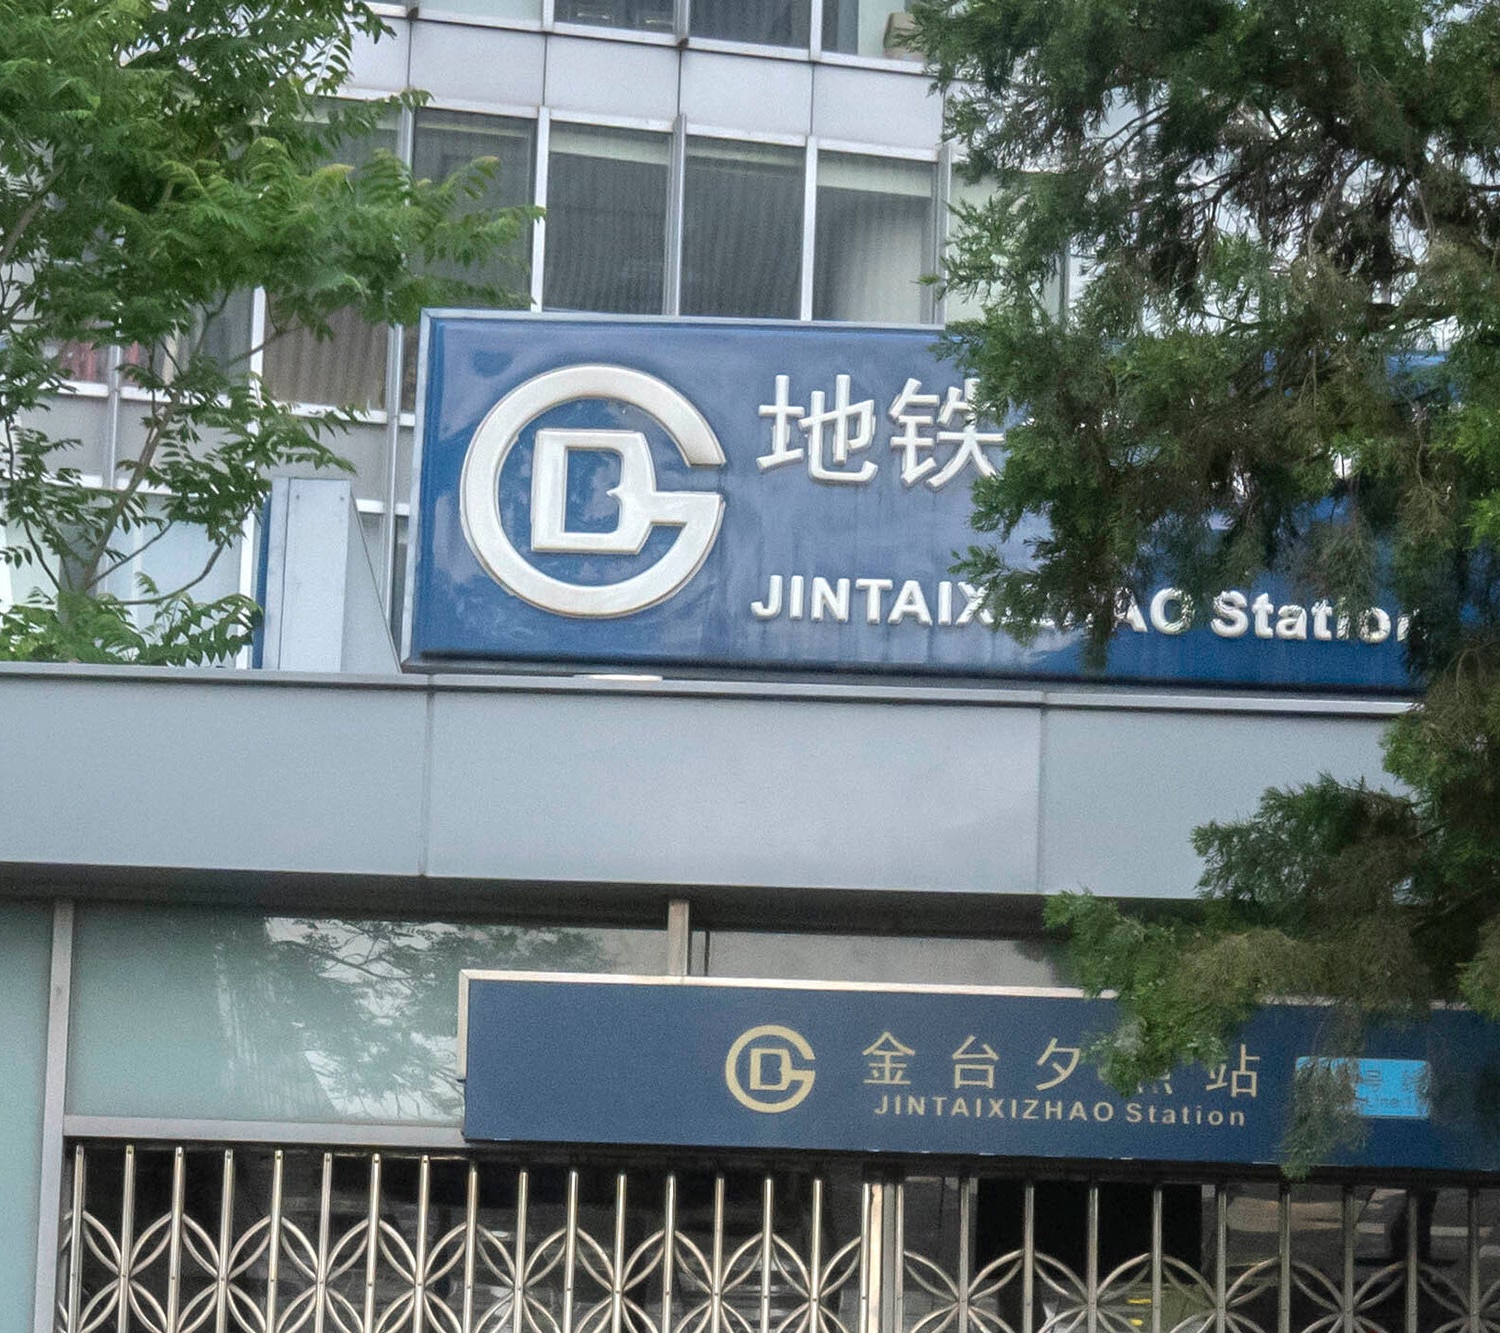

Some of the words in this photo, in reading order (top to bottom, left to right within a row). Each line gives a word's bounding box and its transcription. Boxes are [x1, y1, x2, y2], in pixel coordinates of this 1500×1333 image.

[862, 1031, 1260, 1098] 金台夕站
[874, 1094, 1115, 1122] JINTAIXIZHAO
[1126, 1104, 1246, 1127] Station
